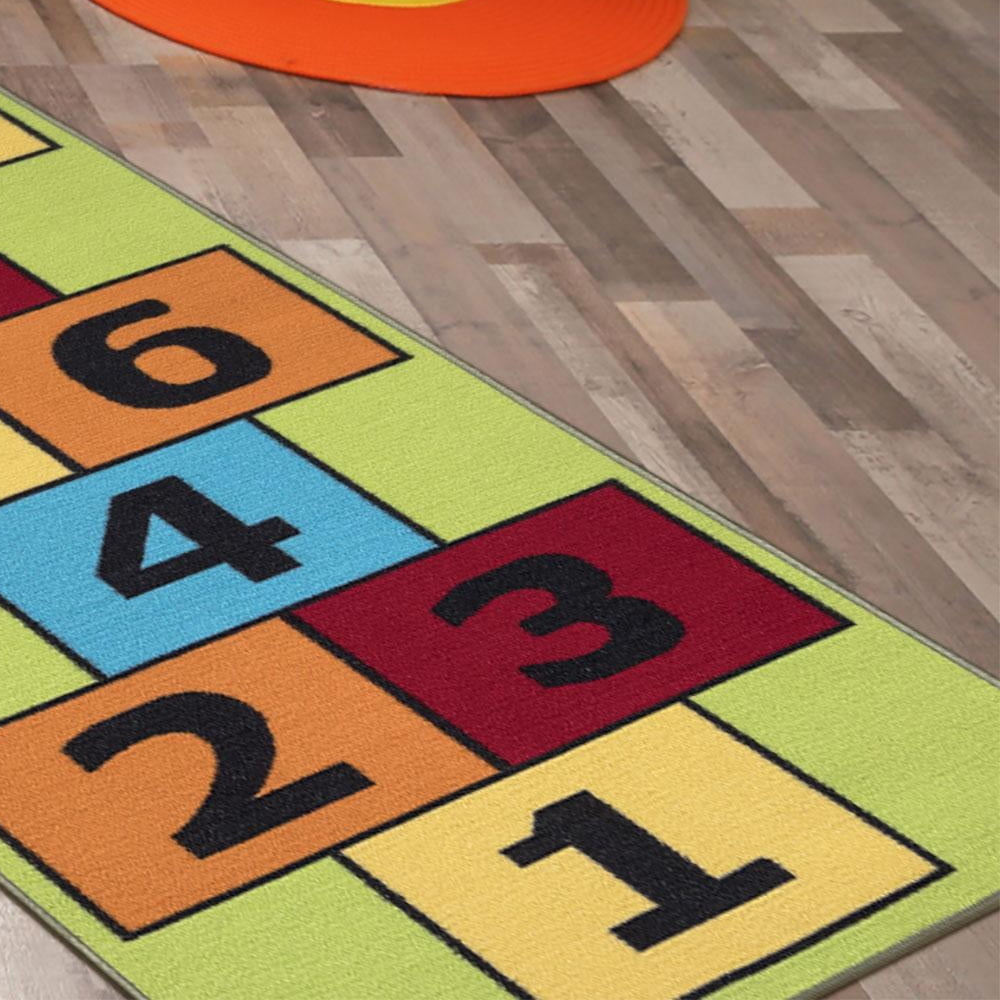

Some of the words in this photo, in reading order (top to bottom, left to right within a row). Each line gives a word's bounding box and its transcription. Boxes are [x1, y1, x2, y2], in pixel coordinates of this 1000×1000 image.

[52, 299, 272, 409] 6
[96, 475, 301, 599] 4
[433, 552, 686, 688] 3
[62, 691, 375, 858] 2
[499, 790, 796, 951] 1
